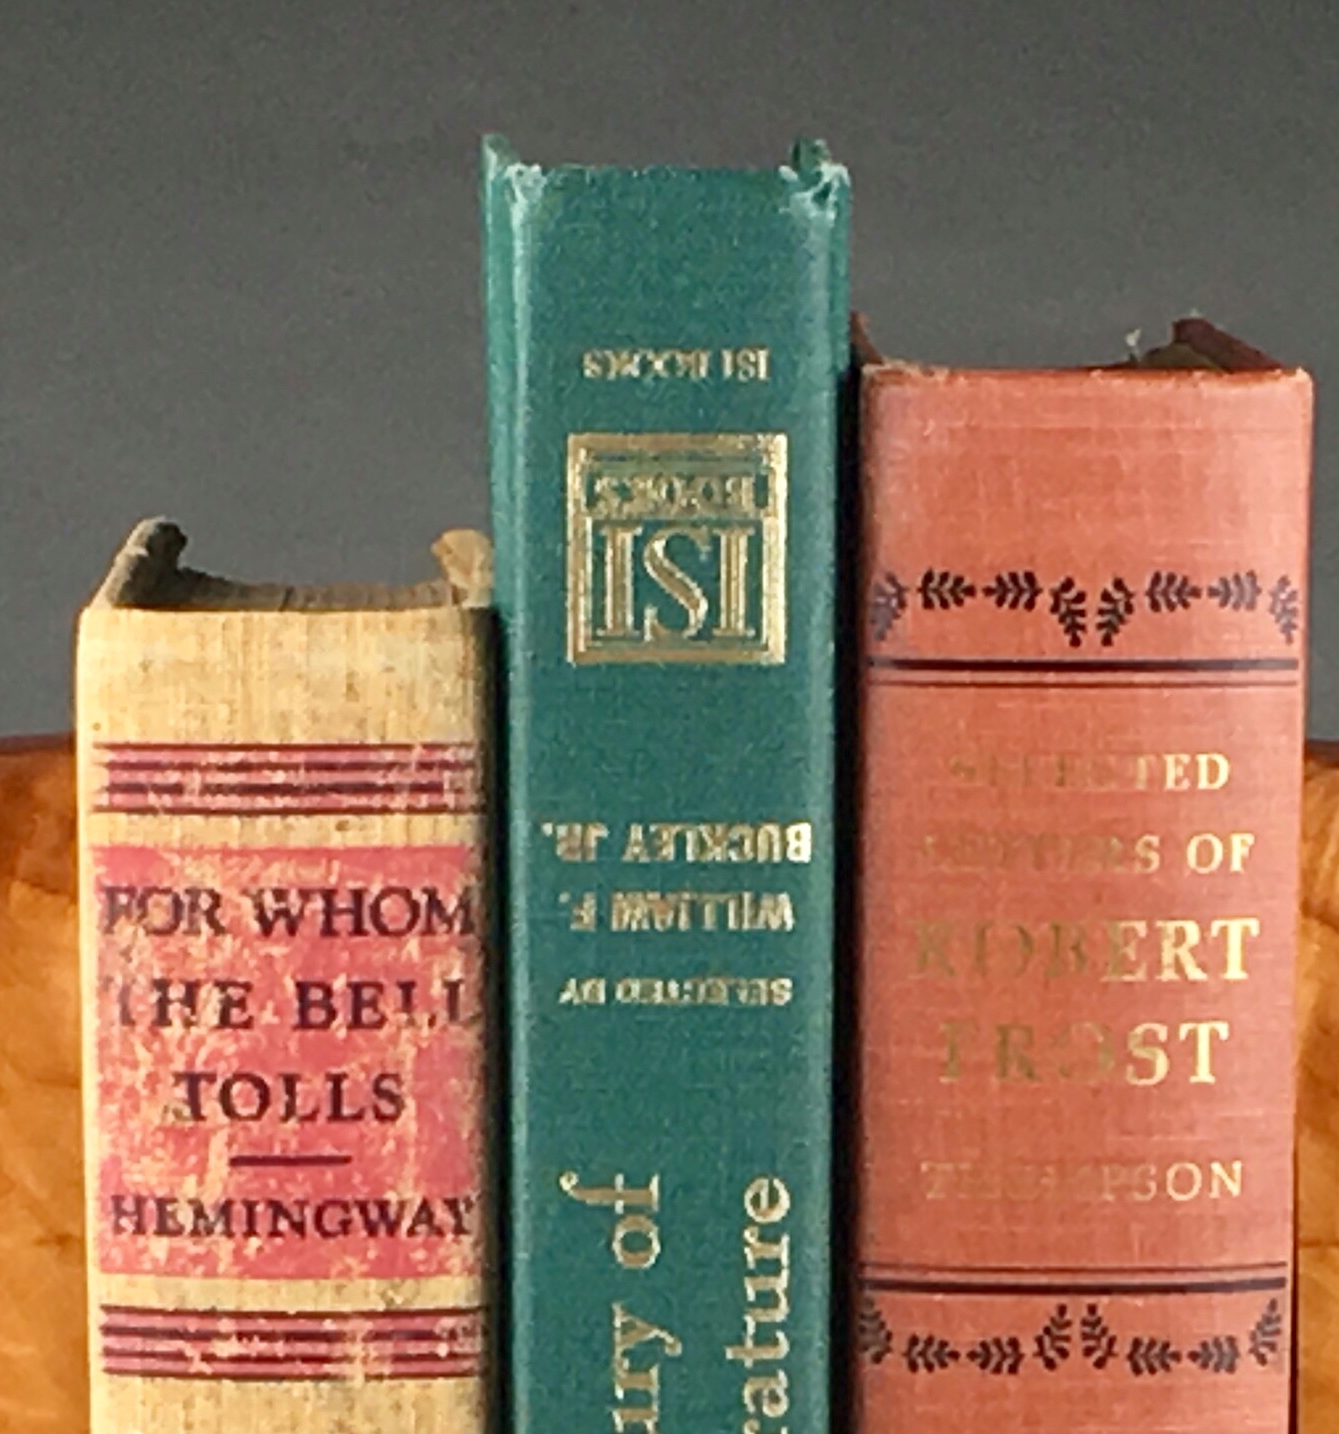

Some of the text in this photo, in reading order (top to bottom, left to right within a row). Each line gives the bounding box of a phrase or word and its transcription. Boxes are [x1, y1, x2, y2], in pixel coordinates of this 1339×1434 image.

[595, 523, 756, 643] ISI
[620, 821, 813, 864] BUCKLEY
[1186, 832, 1255, 874] OF
[102, 885, 474, 938] FOR WHOM
[558, 890, 795, 932] WILLIAM F.
[912, 917, 1261, 982] ROBERT
[558, 977, 794, 1007] SELECTED BY
[936, 1020, 1230, 1087] FROST
[170, 1072, 407, 1123] TOLLS
[110, 1195, 474, 1240] HEMINGWAY
[559, 1172, 661, 1271] of
